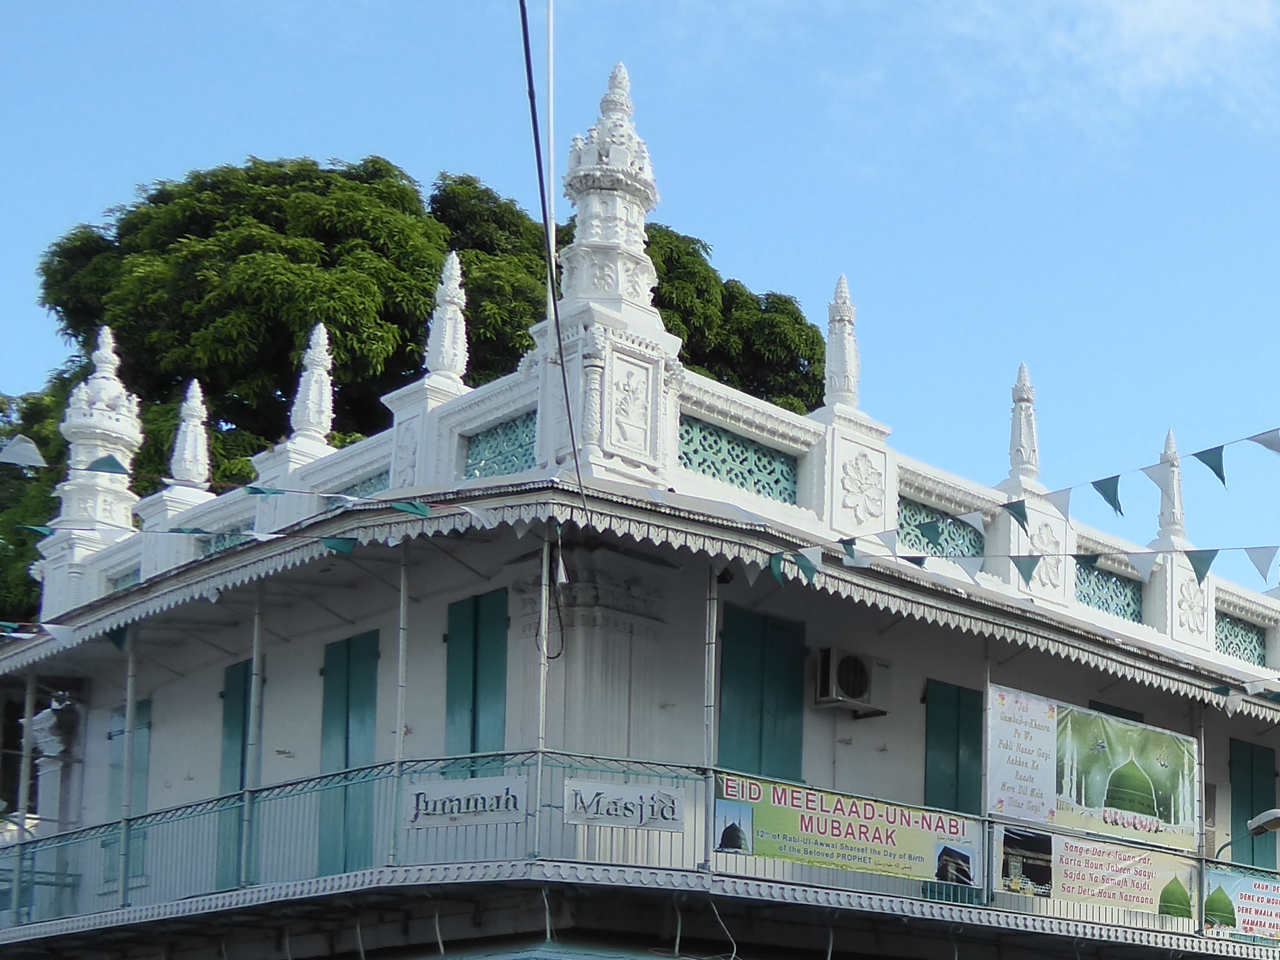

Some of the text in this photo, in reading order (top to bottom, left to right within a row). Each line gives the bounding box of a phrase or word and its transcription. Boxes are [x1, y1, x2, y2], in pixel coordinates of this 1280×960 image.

[409, 786, 519, 823] Jummah
[572, 788, 679, 824] Masjid
[723, 778, 966, 837] EID MEELAAD-UN-NABI
[800, 814, 897, 847] MUBARAK
[804, 848, 834, 859] Beloved
[836, 852, 872, 864] PROPHET
[840, 843, 868, 853] Shareef
[870, 847, 881, 856] the
[883, 850, 896, 860] Day
[1059, 855, 1081, 866] Karta
[1084, 859, 1103, 870] Houn
[1106, 863, 1131, 874] Jabeen
[1063, 869, 1086, 882] Sajda
[1089, 873, 1098, 882] Na
[1101, 875, 1128, 888] Samajh
[1061, 883, 1154, 904] Sar Deta Houn Nazraana
[1240, 893, 1255, 901] DENE
[1238, 906, 1252, 914] DENE
[1255, 909, 1273, 917] WAALA
[1242, 918, 1266, 928] HAMARA
